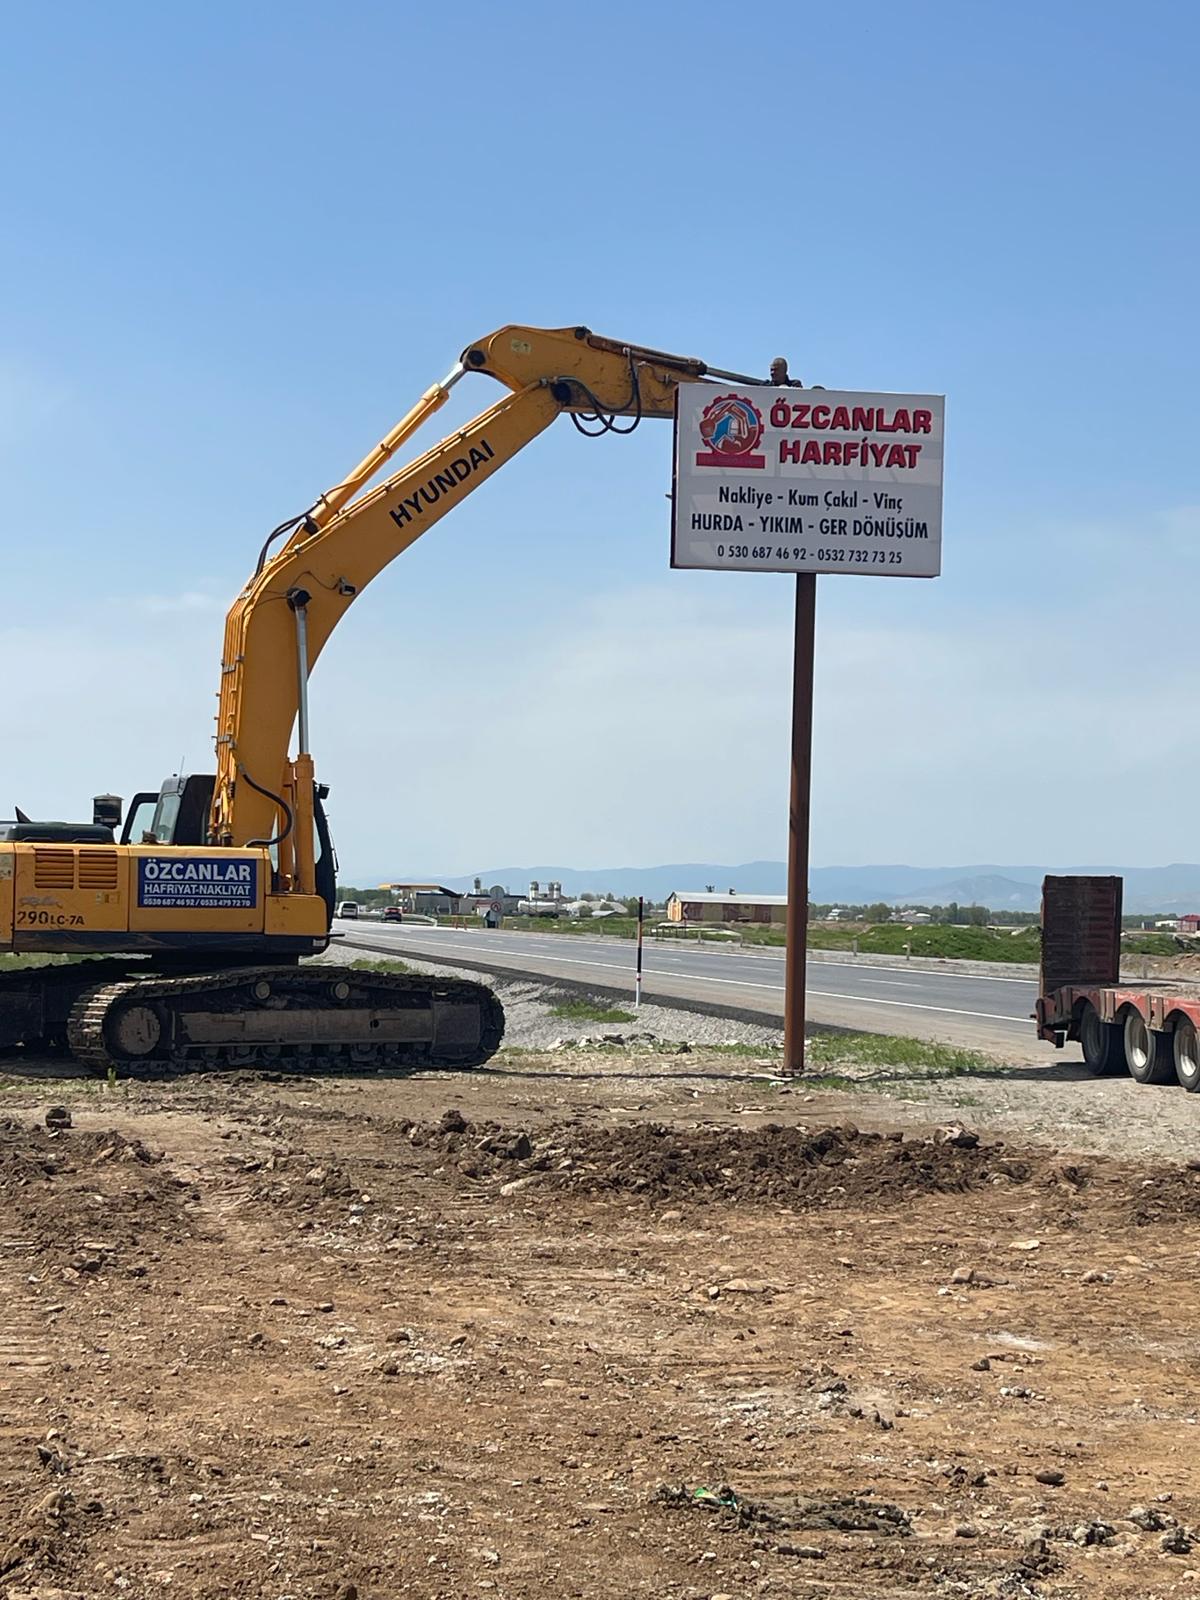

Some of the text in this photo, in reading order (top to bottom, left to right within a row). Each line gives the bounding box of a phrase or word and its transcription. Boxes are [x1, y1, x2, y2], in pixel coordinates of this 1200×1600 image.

[770, 397, 932, 434] ÖZCANLAR
[779, 437, 922, 469] HARFİYAT
[389, 440, 495, 528] HYUNDAI
[719, 486, 773, 509] Nakliye
[788, 489, 819, 507] Kum
[824, 491, 858, 512] Çakıl
[873, 492, 903, 514] Vinç
[691, 513, 744, 532] HURDA
[760, 515, 803, 534] YIKIM
[819, 518, 848, 536] GER
[853, 516, 929, 539] DÖNÜŞÜM
[717, 545, 725, 557] 0
[728, 545, 749, 559] 530
[752, 546, 772, 559] 687
[775, 547, 790, 560] 46
[793, 547, 807, 560] 92
[817, 548, 845, 561] 0532
[848, 549, 868, 562] 732
[872, 550, 886, 563] 73
[888, 550, 903, 564] 25
[144, 858, 251, 881] ÖZCANLAR
